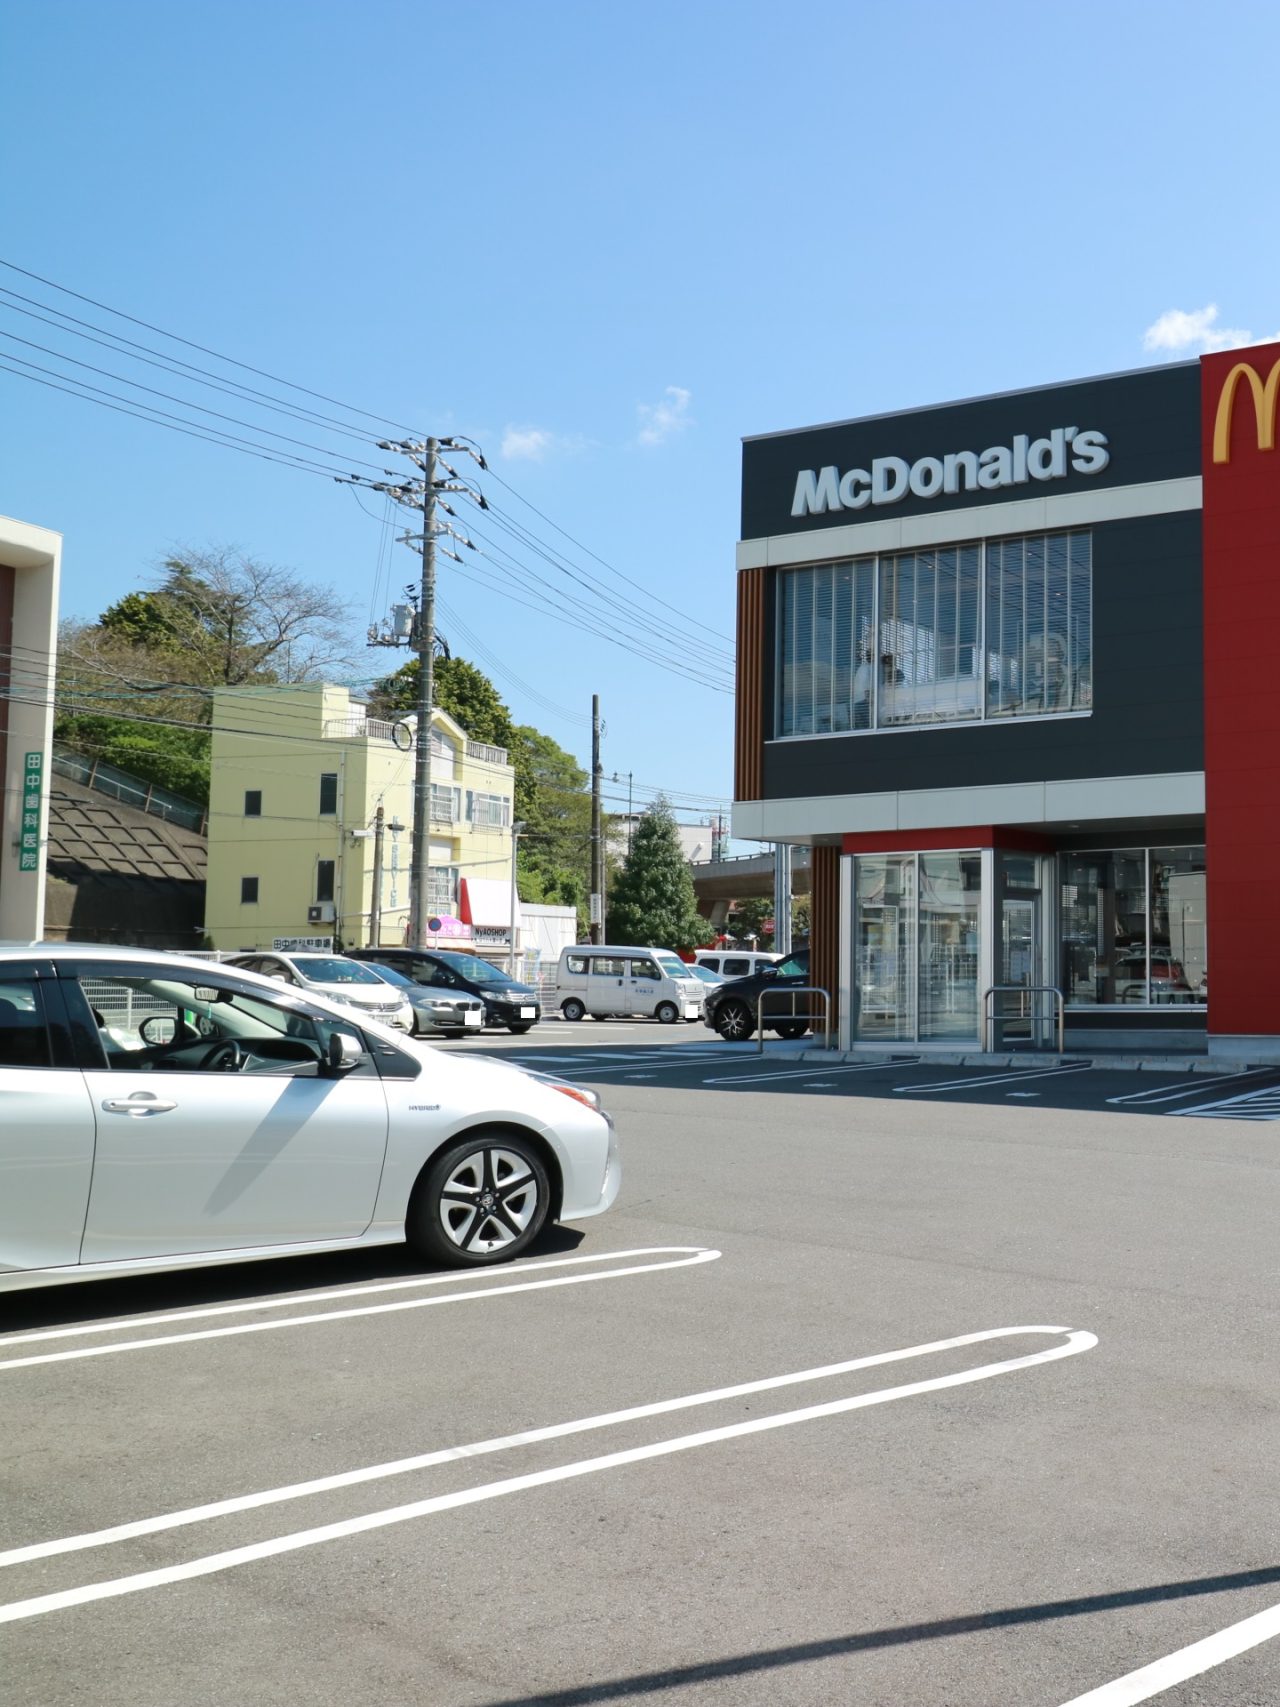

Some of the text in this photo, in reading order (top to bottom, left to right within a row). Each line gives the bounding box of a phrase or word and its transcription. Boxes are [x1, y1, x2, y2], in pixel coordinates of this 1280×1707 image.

[790, 426, 1110, 518] McDonald's
[22, 754, 41, 868] 田中歯科医院
